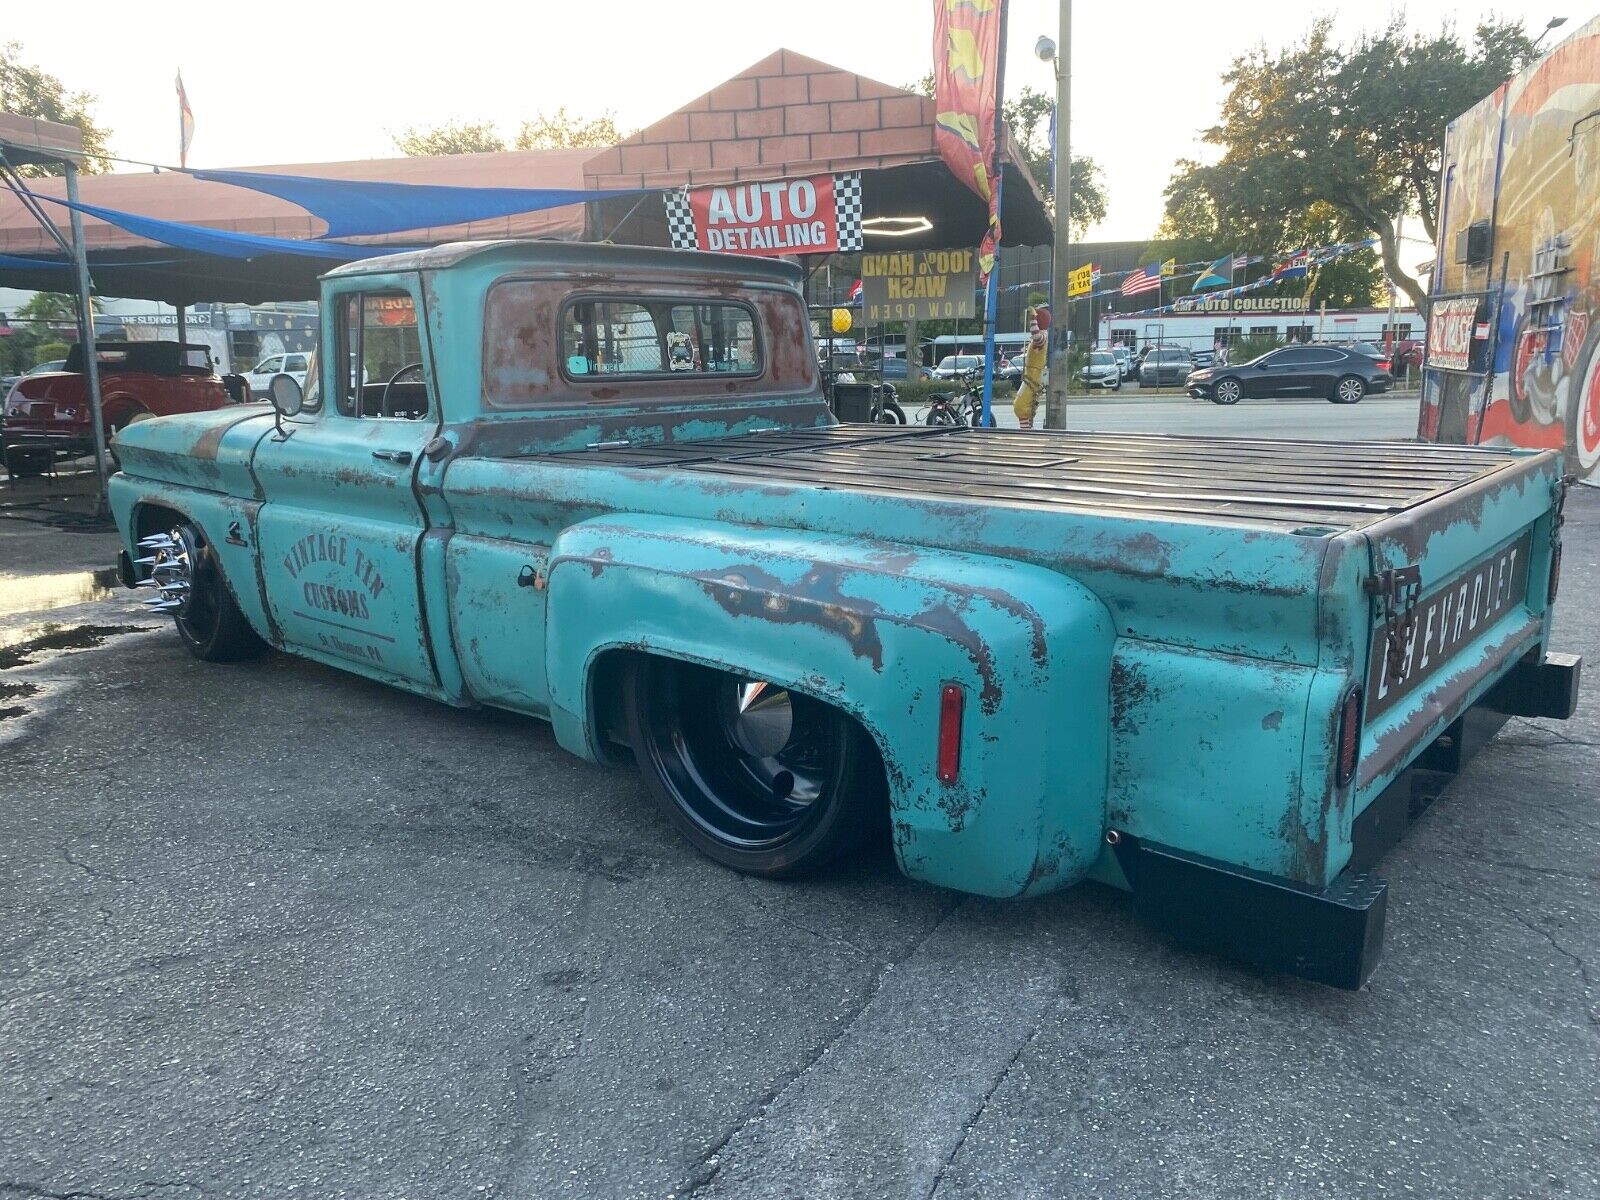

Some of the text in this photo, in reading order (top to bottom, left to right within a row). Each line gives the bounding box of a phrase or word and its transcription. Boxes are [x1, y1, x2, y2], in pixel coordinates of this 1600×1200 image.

[708, 179, 817, 225] AUTO
[706, 221, 827, 251] DETAILING
[172, 315, 197, 324] DOR
[1196, 298, 1230, 311] AUTO
[284, 533, 385, 600] VINTAGE TIN
[303, 582, 369, 620] CUSTOMS
[1377, 548, 1517, 700] CHEVROLET
